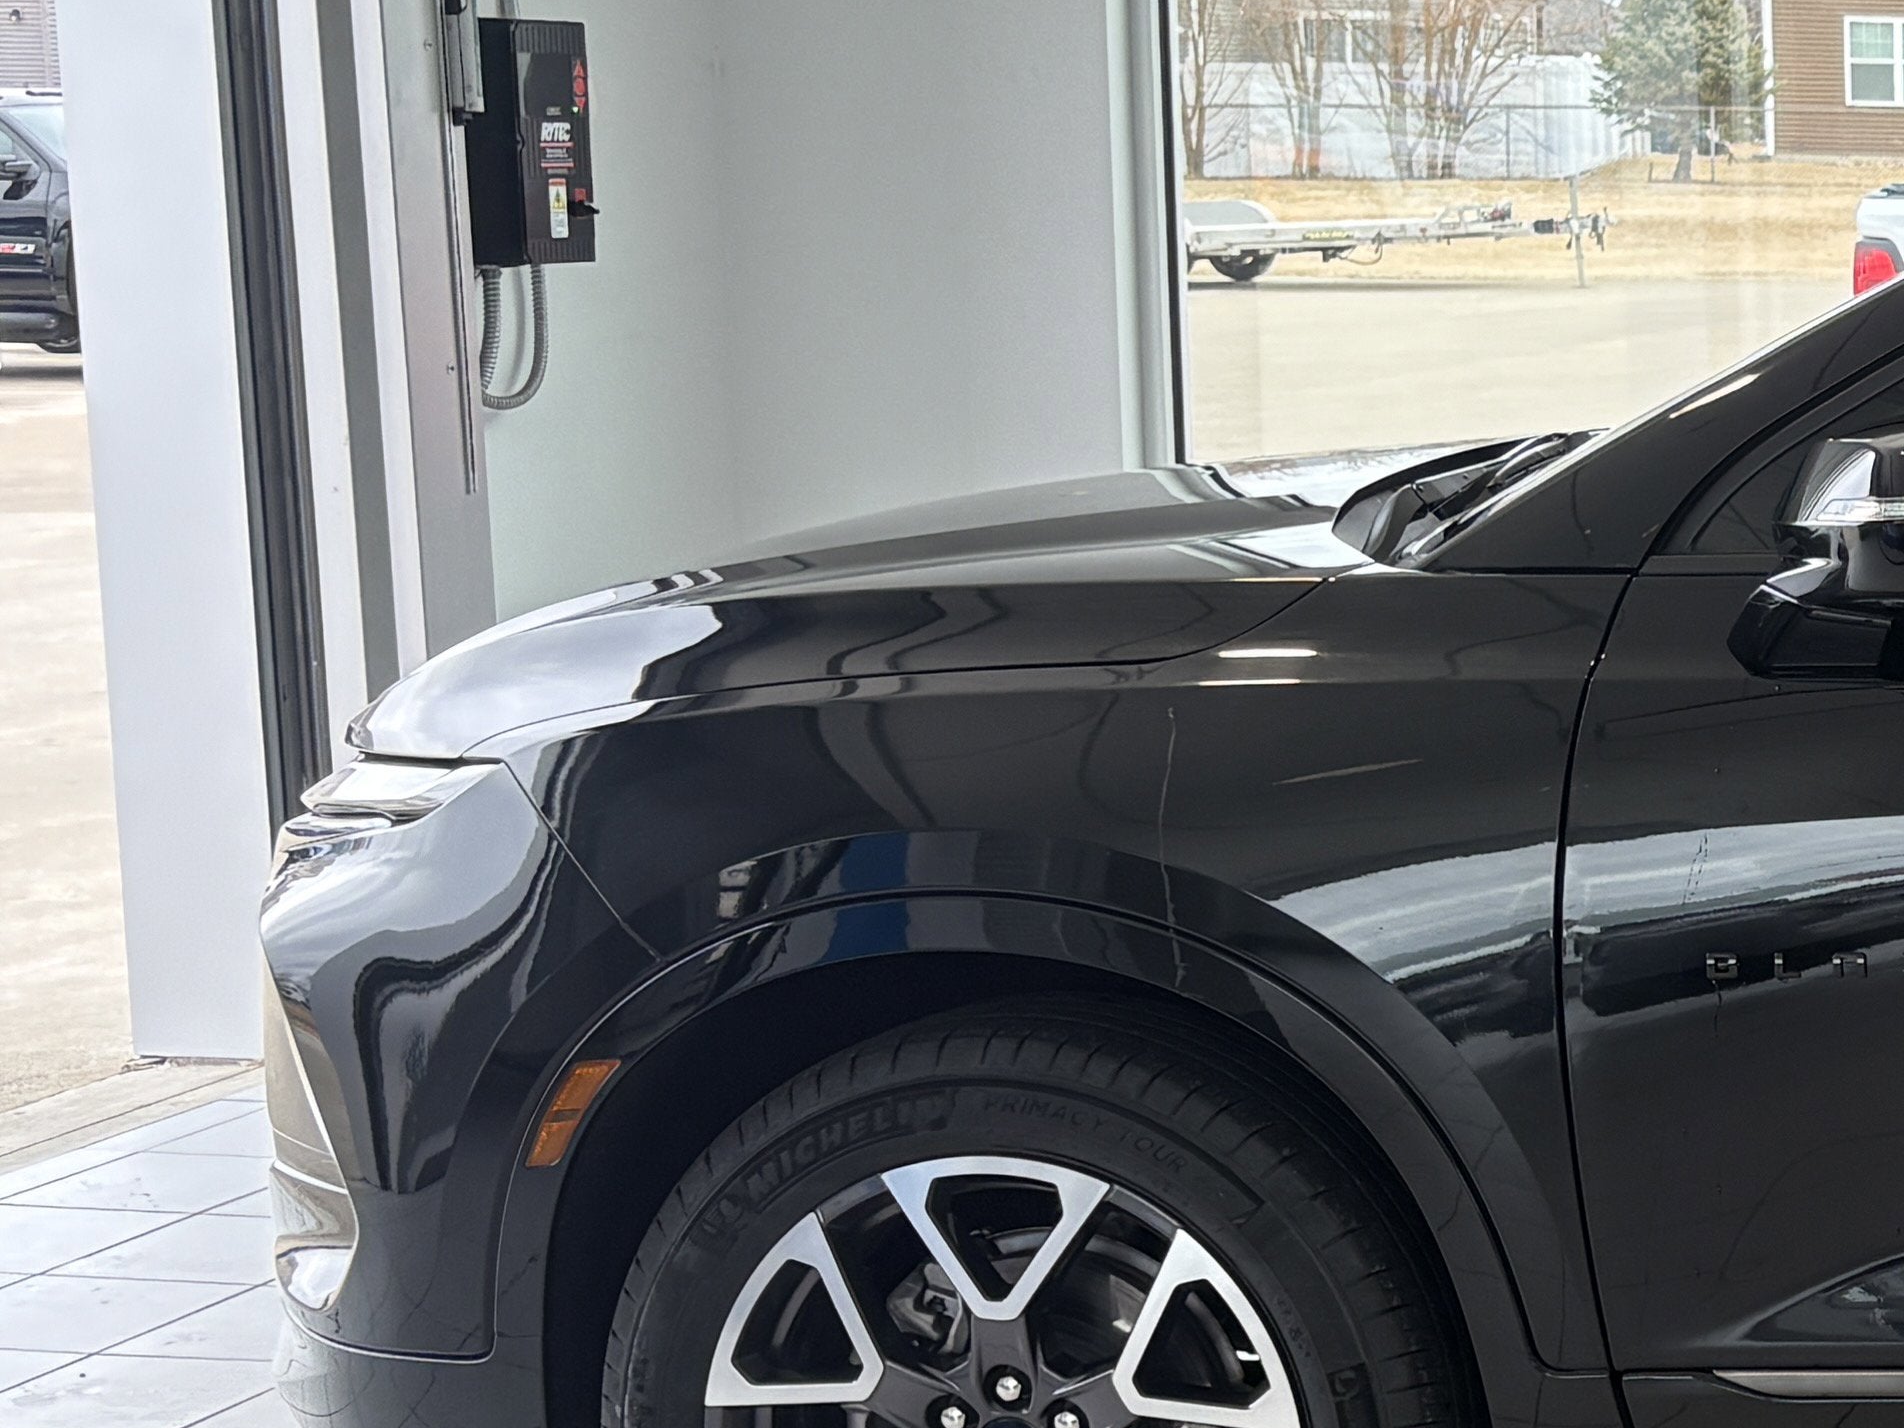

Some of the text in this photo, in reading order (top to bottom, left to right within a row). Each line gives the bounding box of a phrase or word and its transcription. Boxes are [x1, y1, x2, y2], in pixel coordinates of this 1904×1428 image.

[747, 1093, 948, 1202] MICHELIN
[984, 1098, 1189, 1173] PRIMACY TOUR
